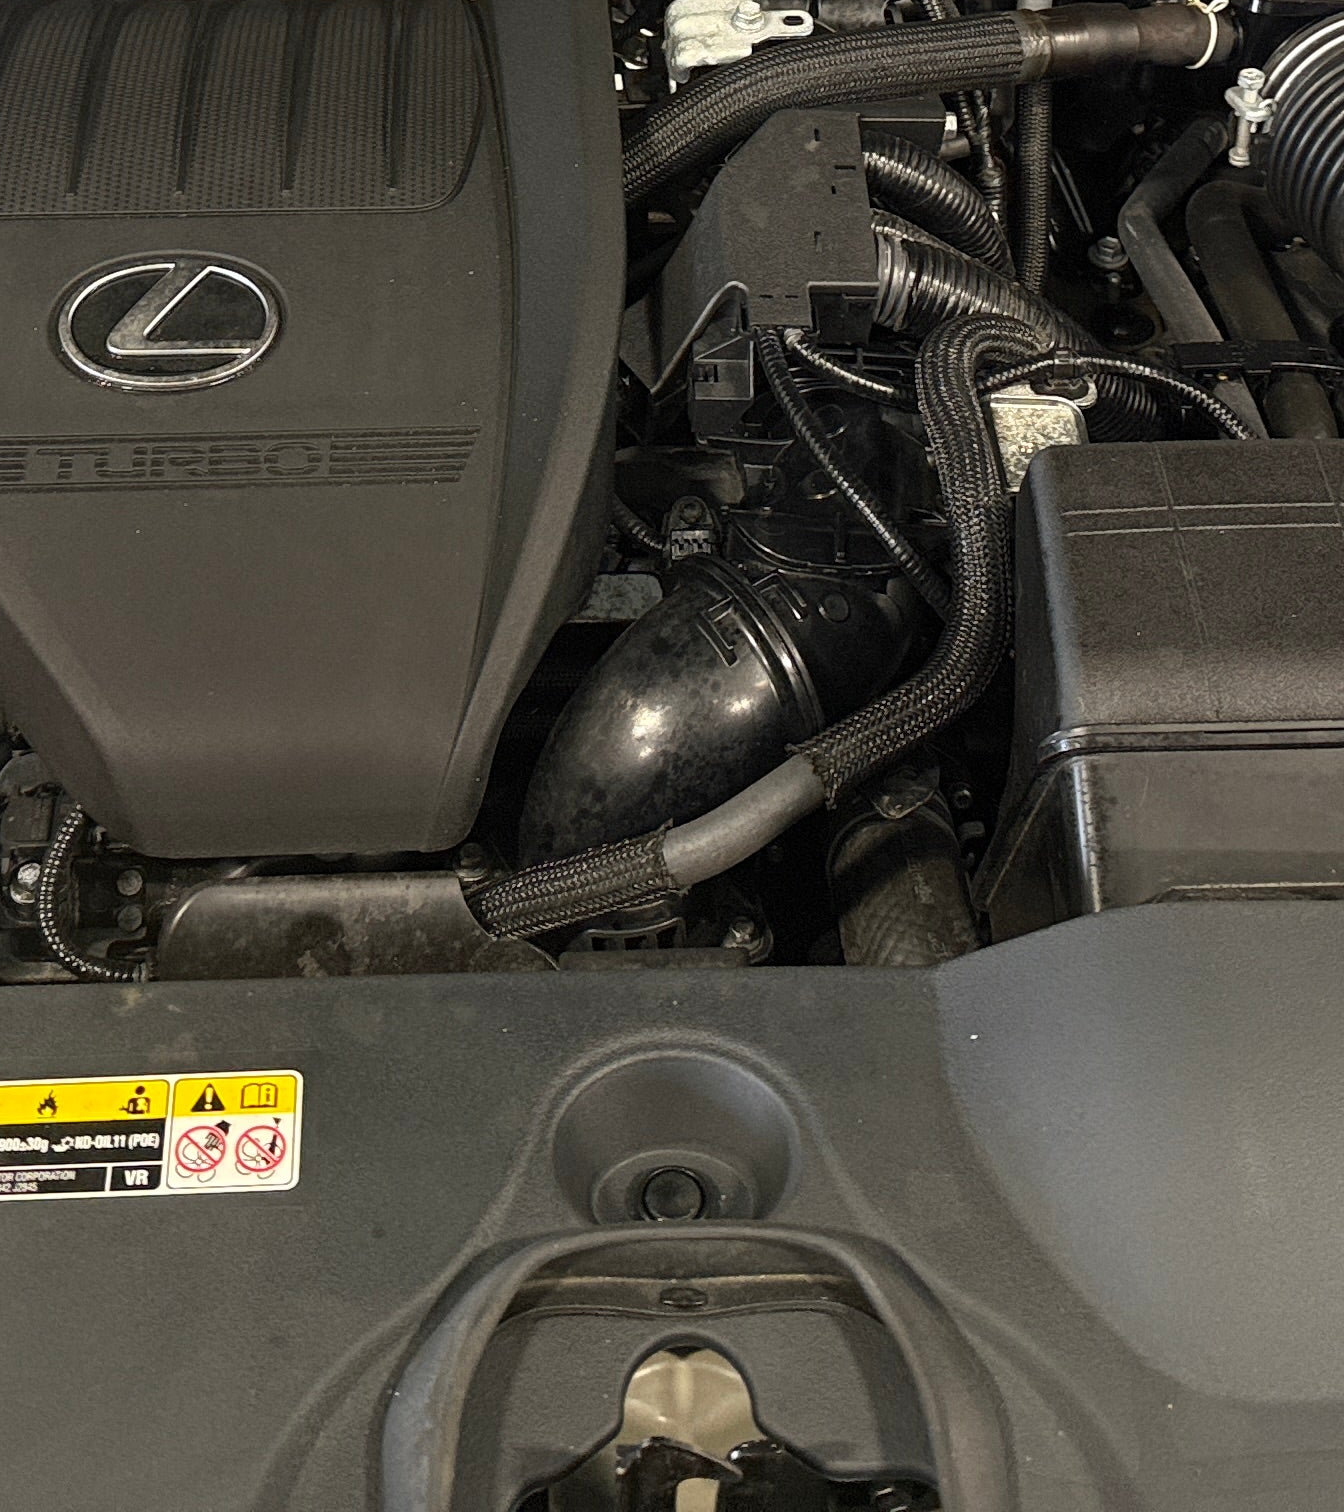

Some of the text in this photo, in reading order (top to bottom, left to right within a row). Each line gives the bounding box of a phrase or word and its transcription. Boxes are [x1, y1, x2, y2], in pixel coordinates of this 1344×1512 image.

[36, 441, 323, 480] TURBO
[128, 1132, 160, 1150] (POE)
[15, 1169, 76, 1182] CORPORATION
[124, 1169, 149, 1186] VR
